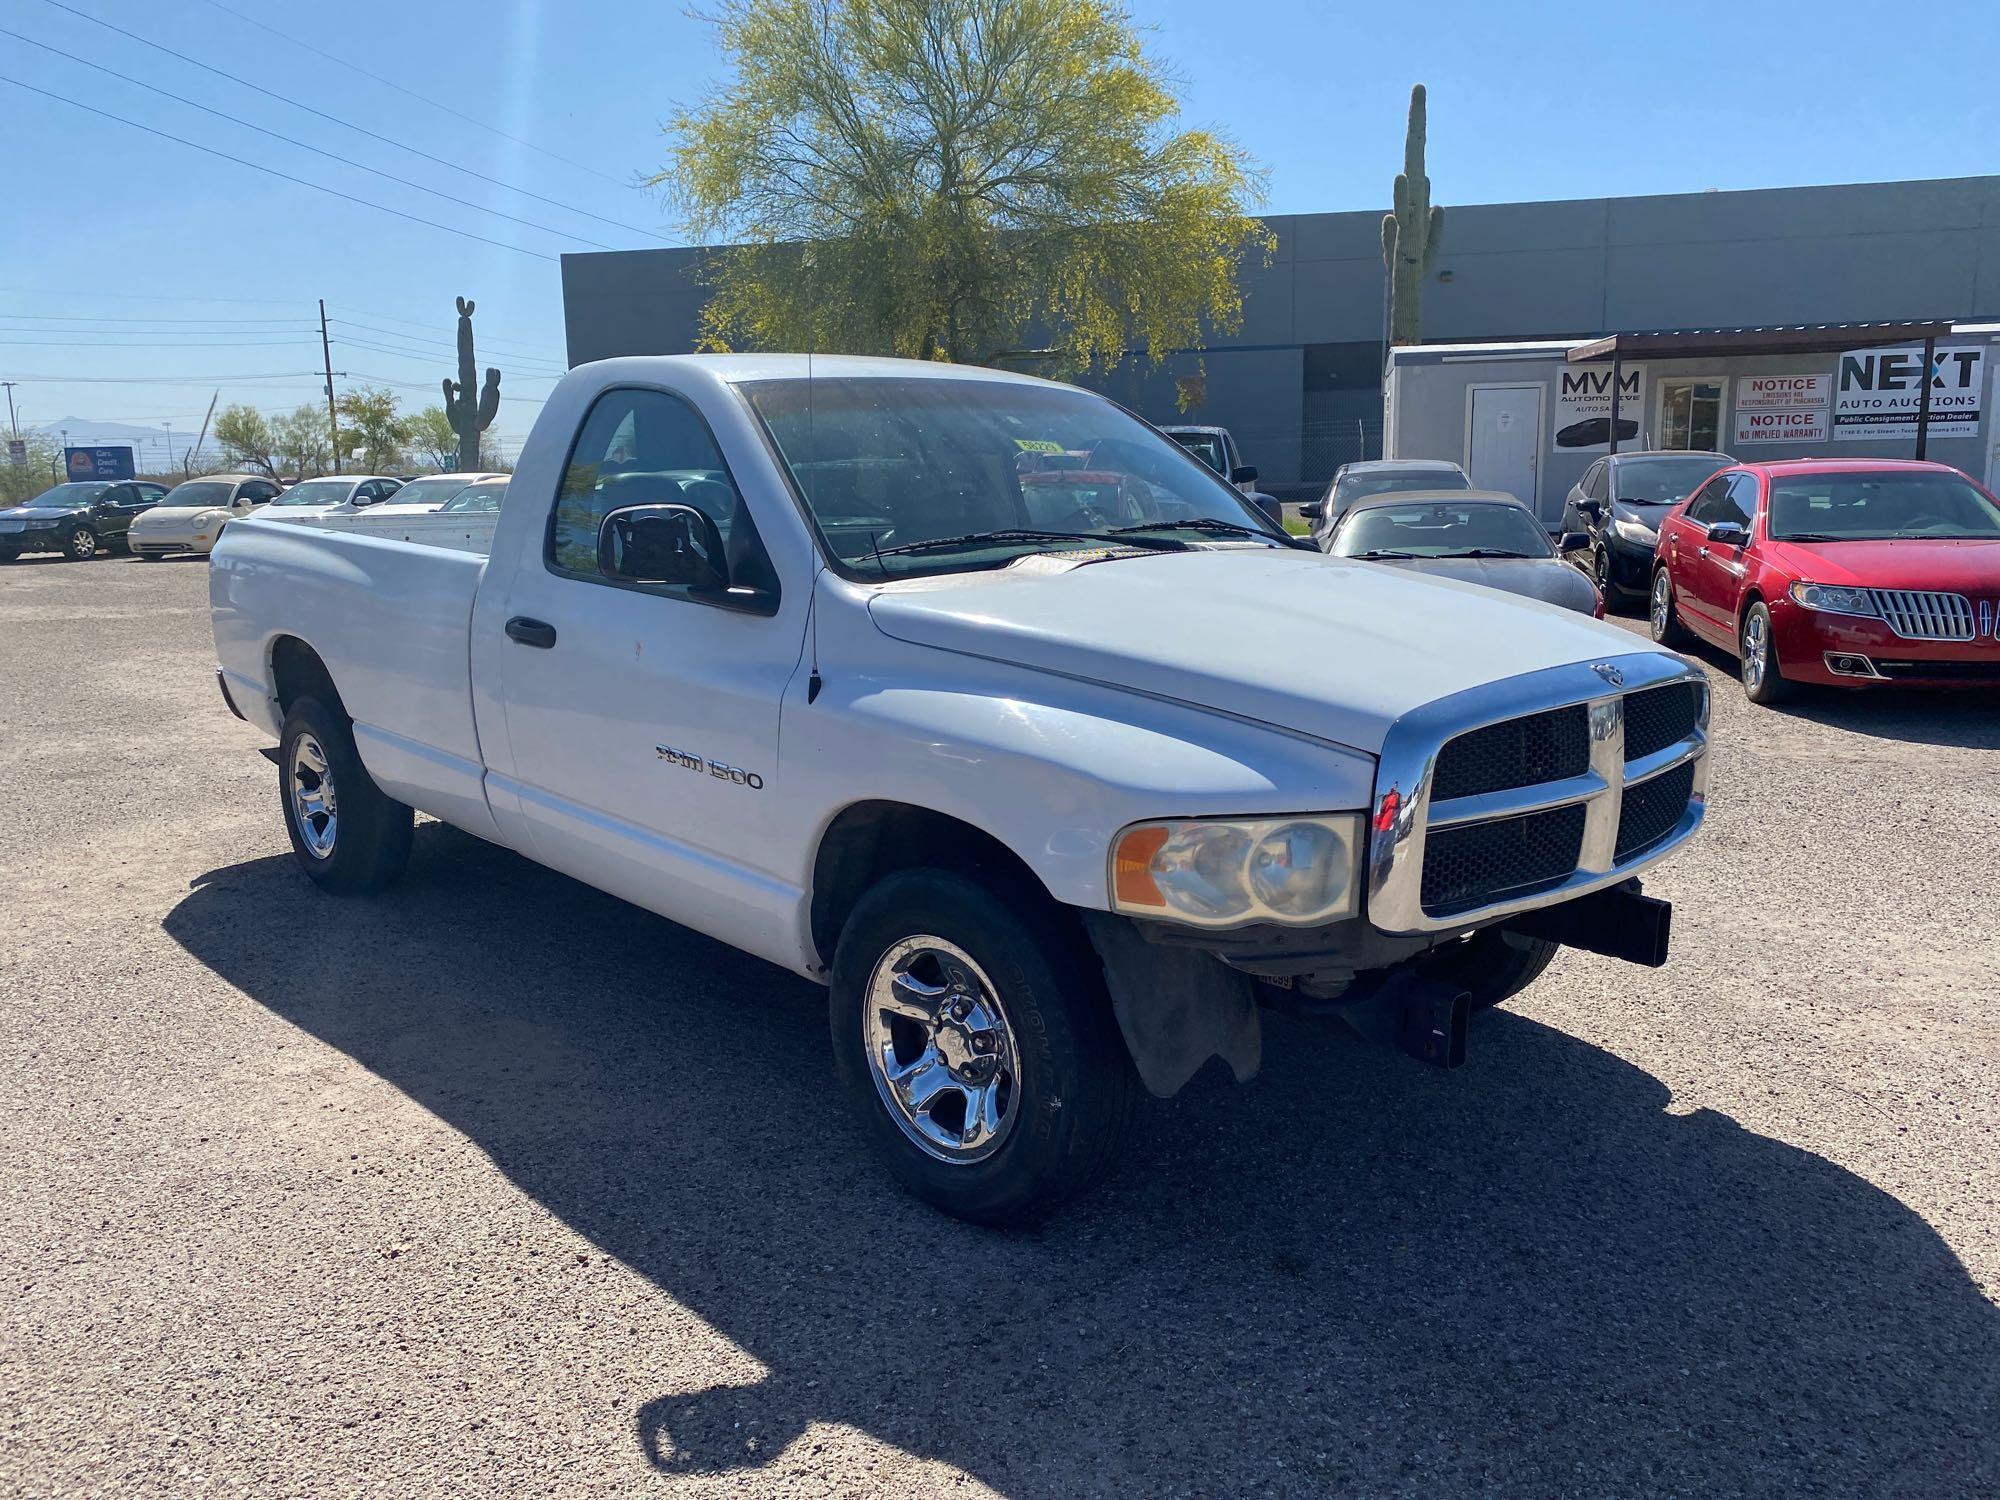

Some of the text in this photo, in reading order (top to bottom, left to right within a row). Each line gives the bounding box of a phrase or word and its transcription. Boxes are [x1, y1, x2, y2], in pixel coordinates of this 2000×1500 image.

[1840, 351, 1981, 391] NEXT
[1562, 371, 1640, 394] MVM
[1752, 378, 1817, 391] NOTICE
[1741, 398, 1783, 406] RESPONSIBILITY
[1793, 397, 1825, 405] PURCHASER
[1839, 396, 1976, 409] AUTO AUCIONS
[1750, 414, 1814, 426] NOTICE
[1839, 415, 1863, 423] Public
[1864, 414, 1914, 423] Consignment
[1739, 428, 1823, 440] NO IMPLIED WARRANTY
[706, 759, 764, 790] 1500
